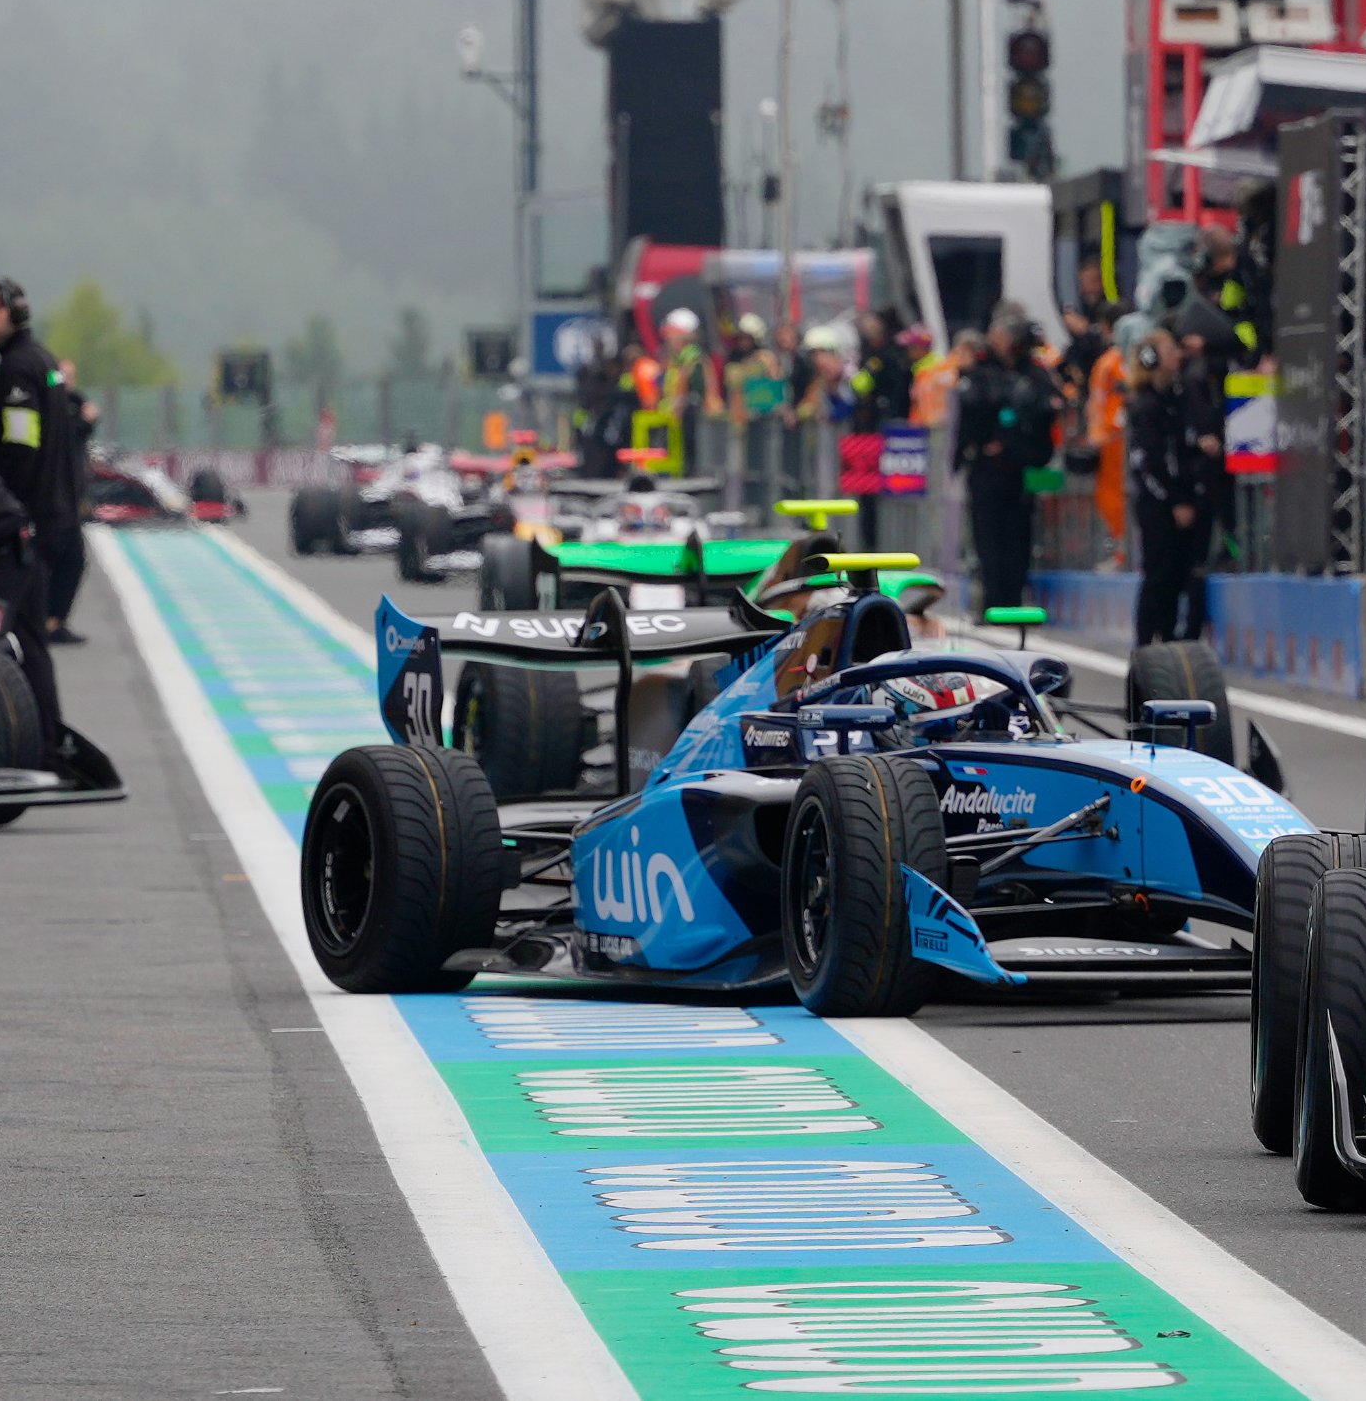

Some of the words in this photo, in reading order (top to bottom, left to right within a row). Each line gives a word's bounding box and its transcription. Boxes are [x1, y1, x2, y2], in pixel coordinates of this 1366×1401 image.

[509, 613, 687, 640] SUMEC
[902, 685, 926, 702] win
[403, 672, 434, 746] 30
[940, 783, 1036, 814] Andalucita
[1178, 776, 1275, 806] 30
[1216, 806, 1261, 814] LUCAS
[1266, 806, 1288, 814] OIL
[593, 825, 695, 924] win
[915, 927, 948, 952] PIRELLI
[669, 1279, 1188, 1396] aramco
